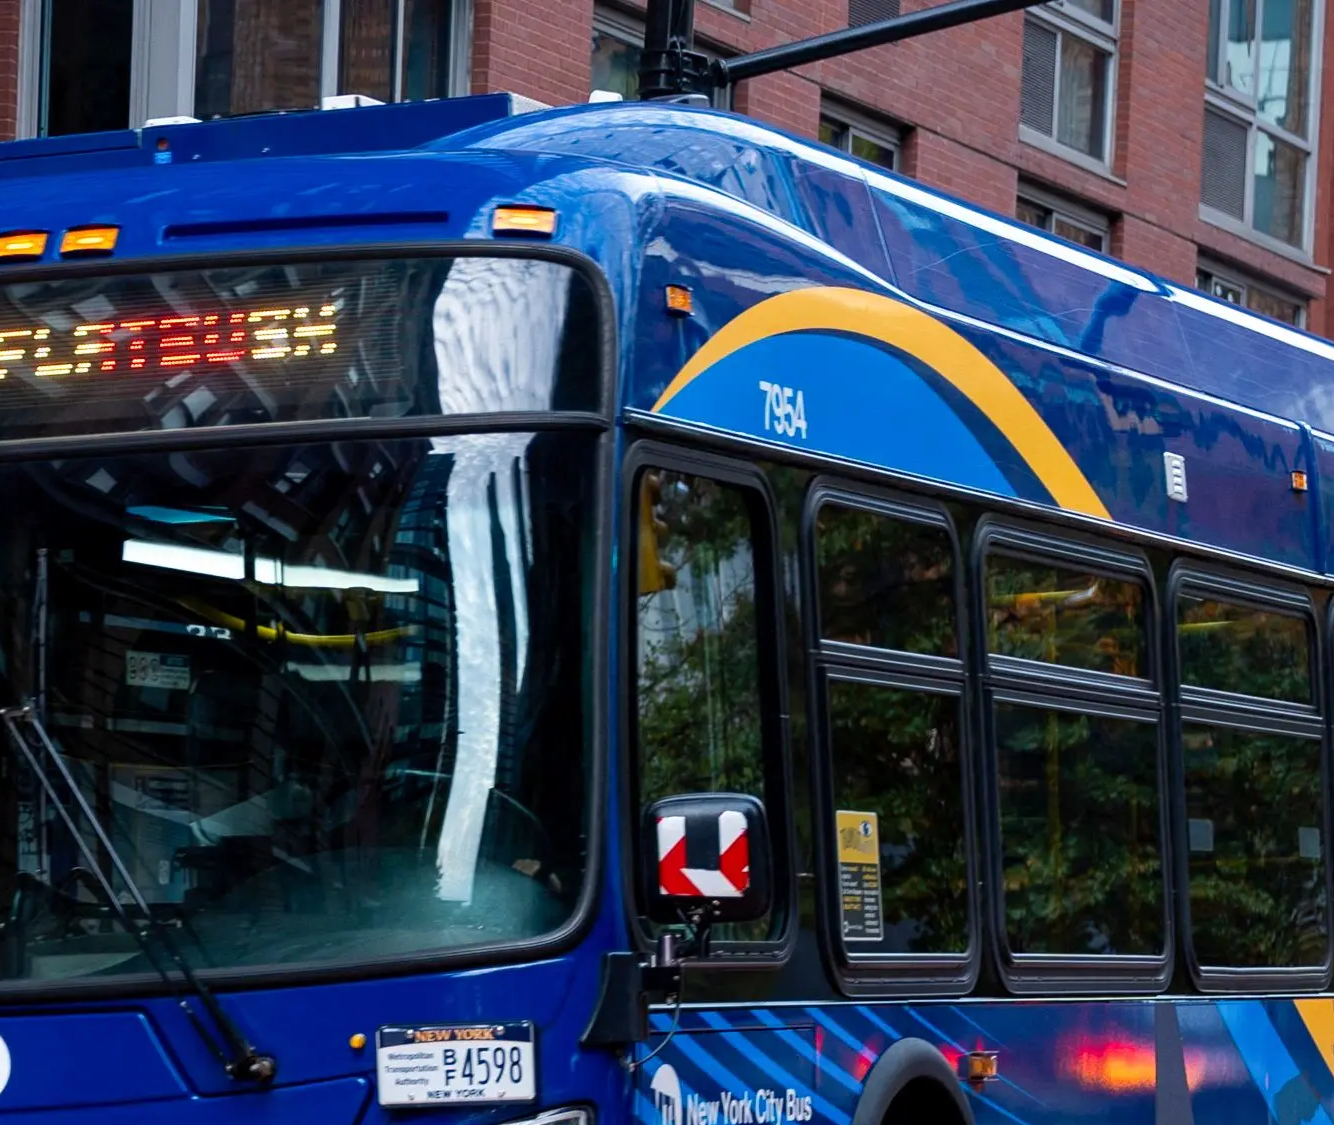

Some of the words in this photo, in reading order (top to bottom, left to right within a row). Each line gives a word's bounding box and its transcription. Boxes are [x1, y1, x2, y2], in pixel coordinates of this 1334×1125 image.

[759, 380, 807, 439] 7954
[414, 1030, 451, 1042] NEW
[454, 1028, 496, 1041] YORK
[387, 1052, 435, 1061] Metropolitan
[462, 1046, 523, 1086] 4598
[394, 1077, 430, 1087] Authority
[427, 1089, 452, 1100] NEW
[455, 1088, 486, 1099] YORK
[721, 1090, 753, 1125] York
[786, 1088, 813, 1122] Bus
